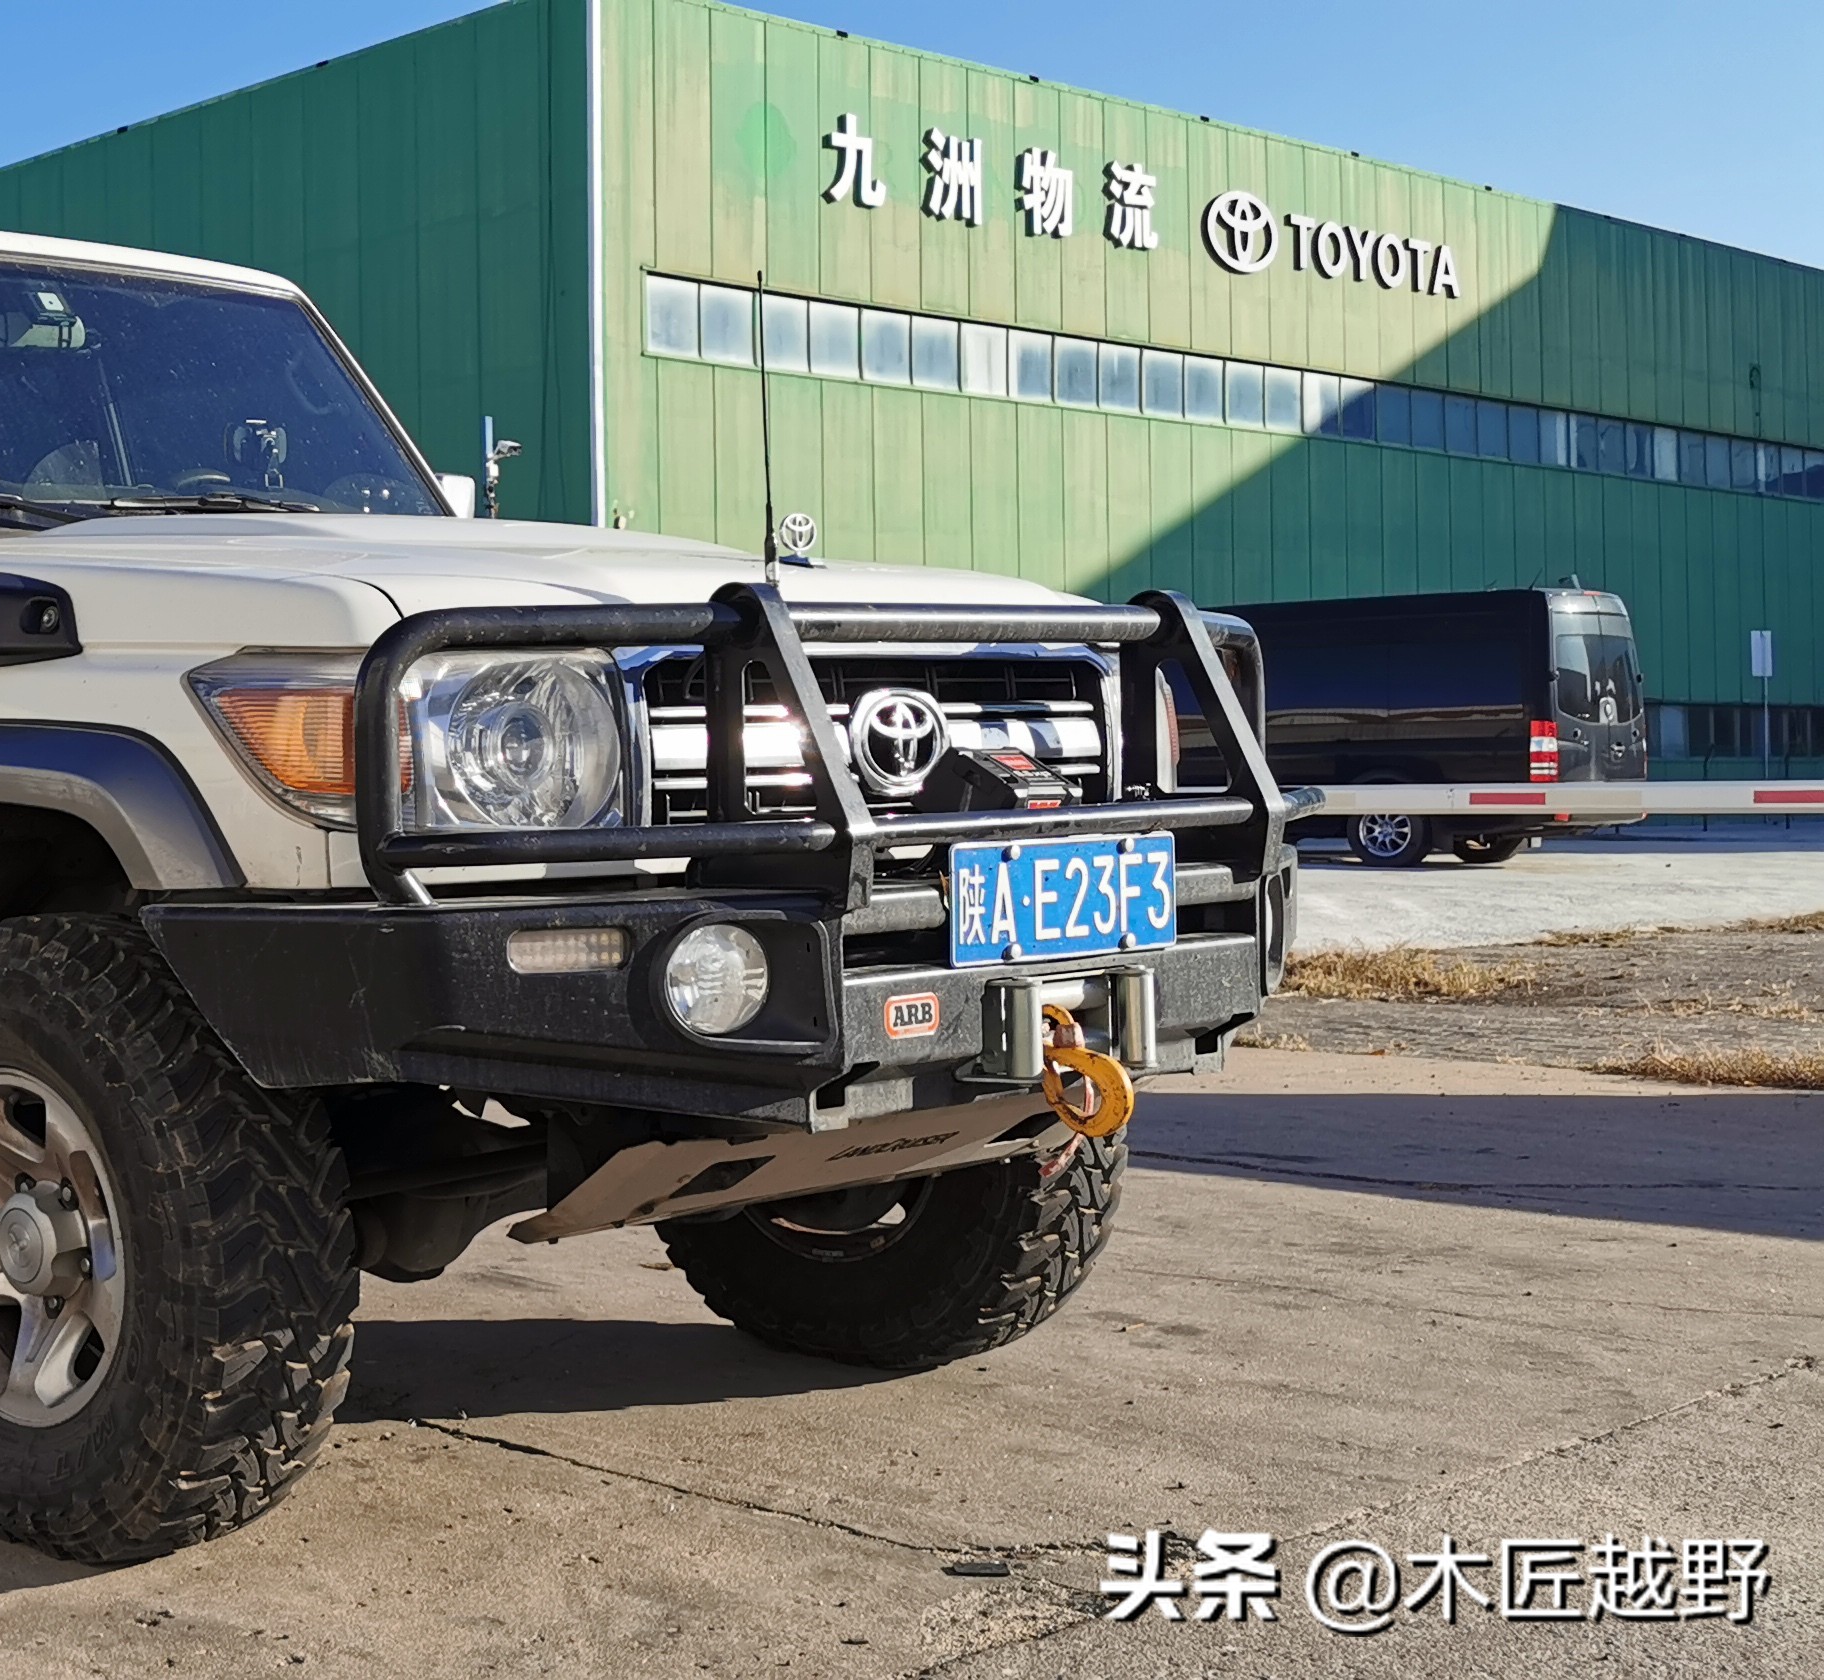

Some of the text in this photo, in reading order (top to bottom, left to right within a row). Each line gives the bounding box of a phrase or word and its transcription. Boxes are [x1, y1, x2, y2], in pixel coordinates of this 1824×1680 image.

[822, 112, 1159, 251] 九洲物流
[1284, 213, 1461, 299] TOYOTA
[892, 1002, 933, 1028] ARB
